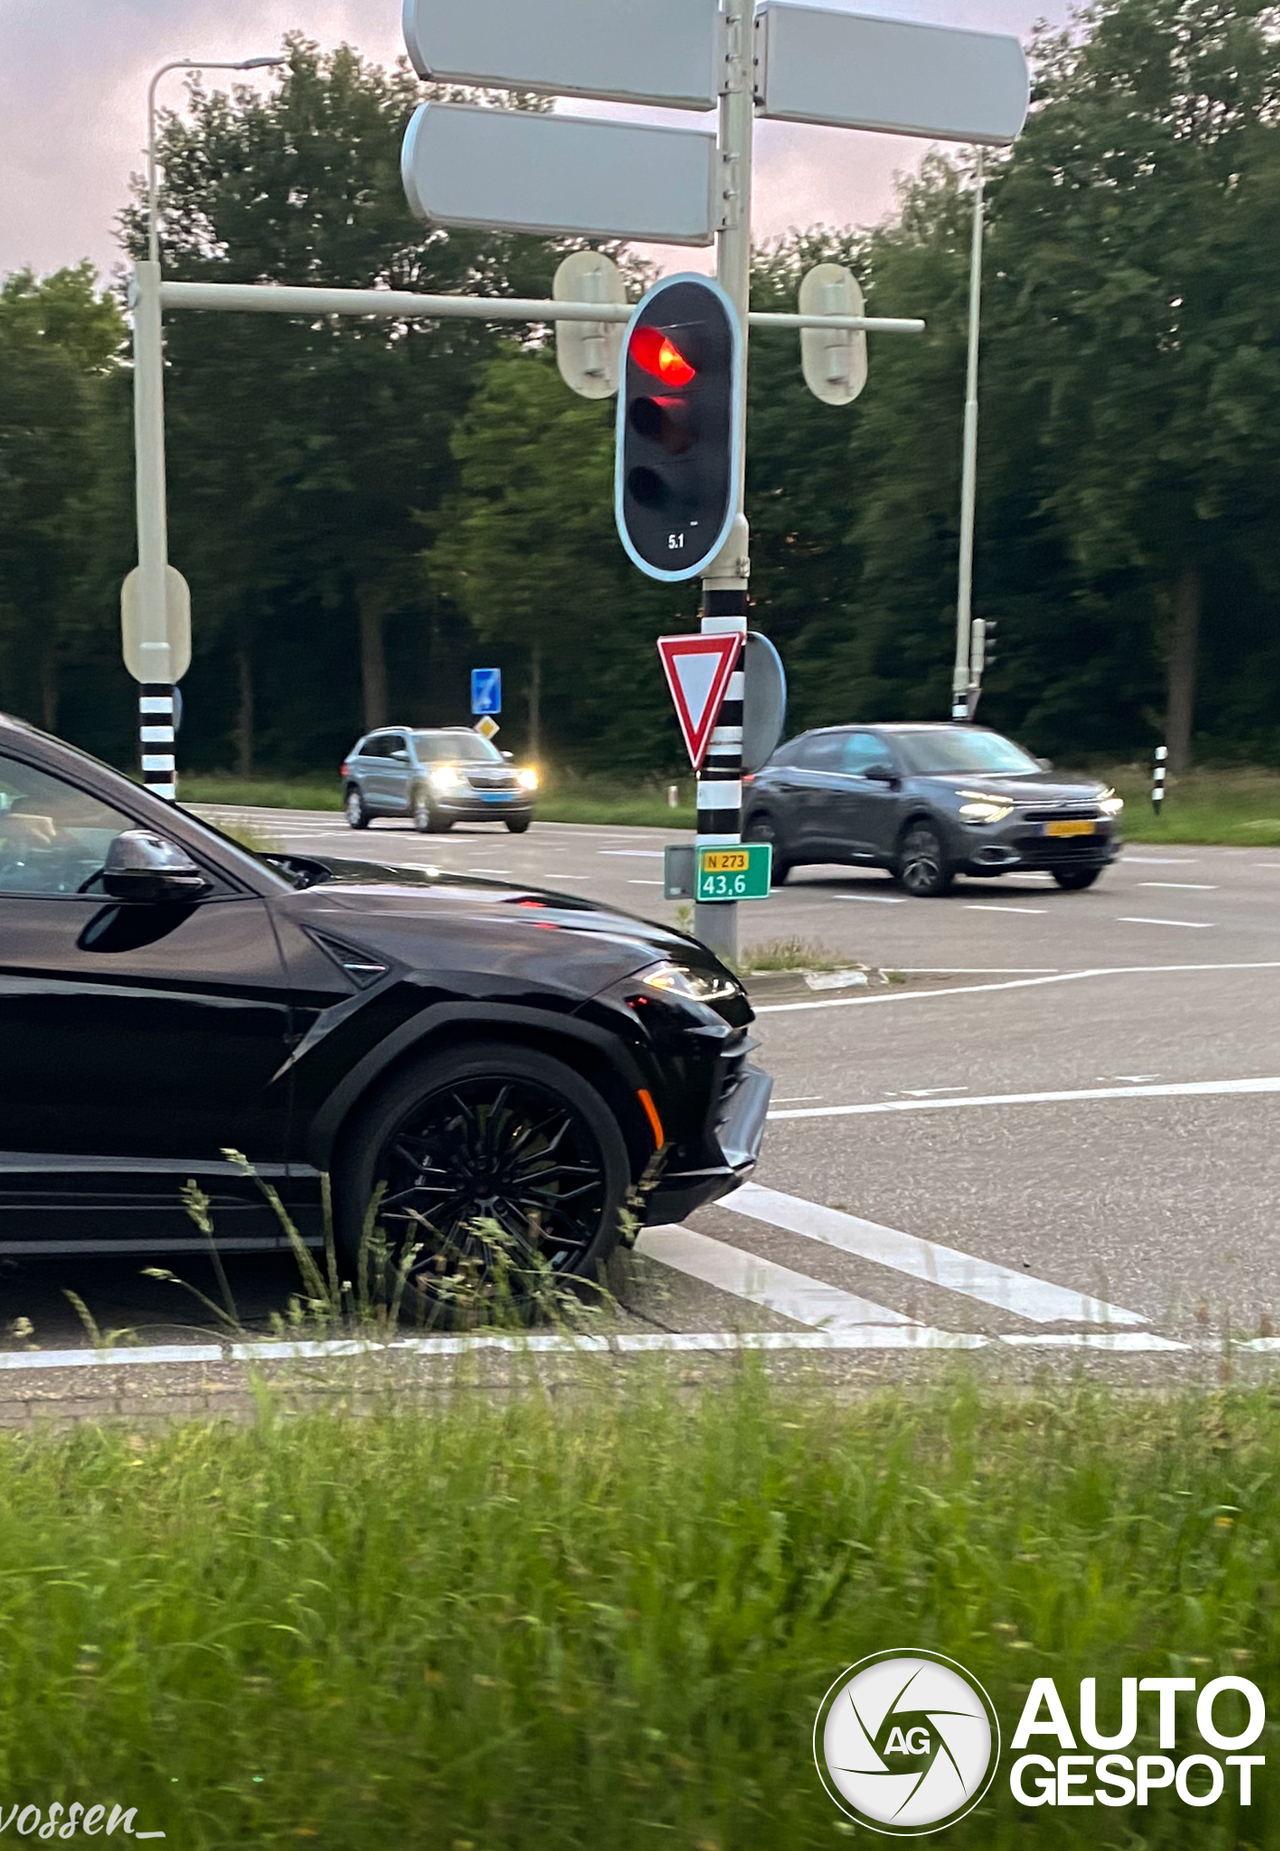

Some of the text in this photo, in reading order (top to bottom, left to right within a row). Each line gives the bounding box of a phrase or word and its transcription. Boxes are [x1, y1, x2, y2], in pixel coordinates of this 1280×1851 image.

[668, 533, 684, 549] 5.1
[708, 855, 745, 868] N 273
[703, 875, 746, 895] 43,6
